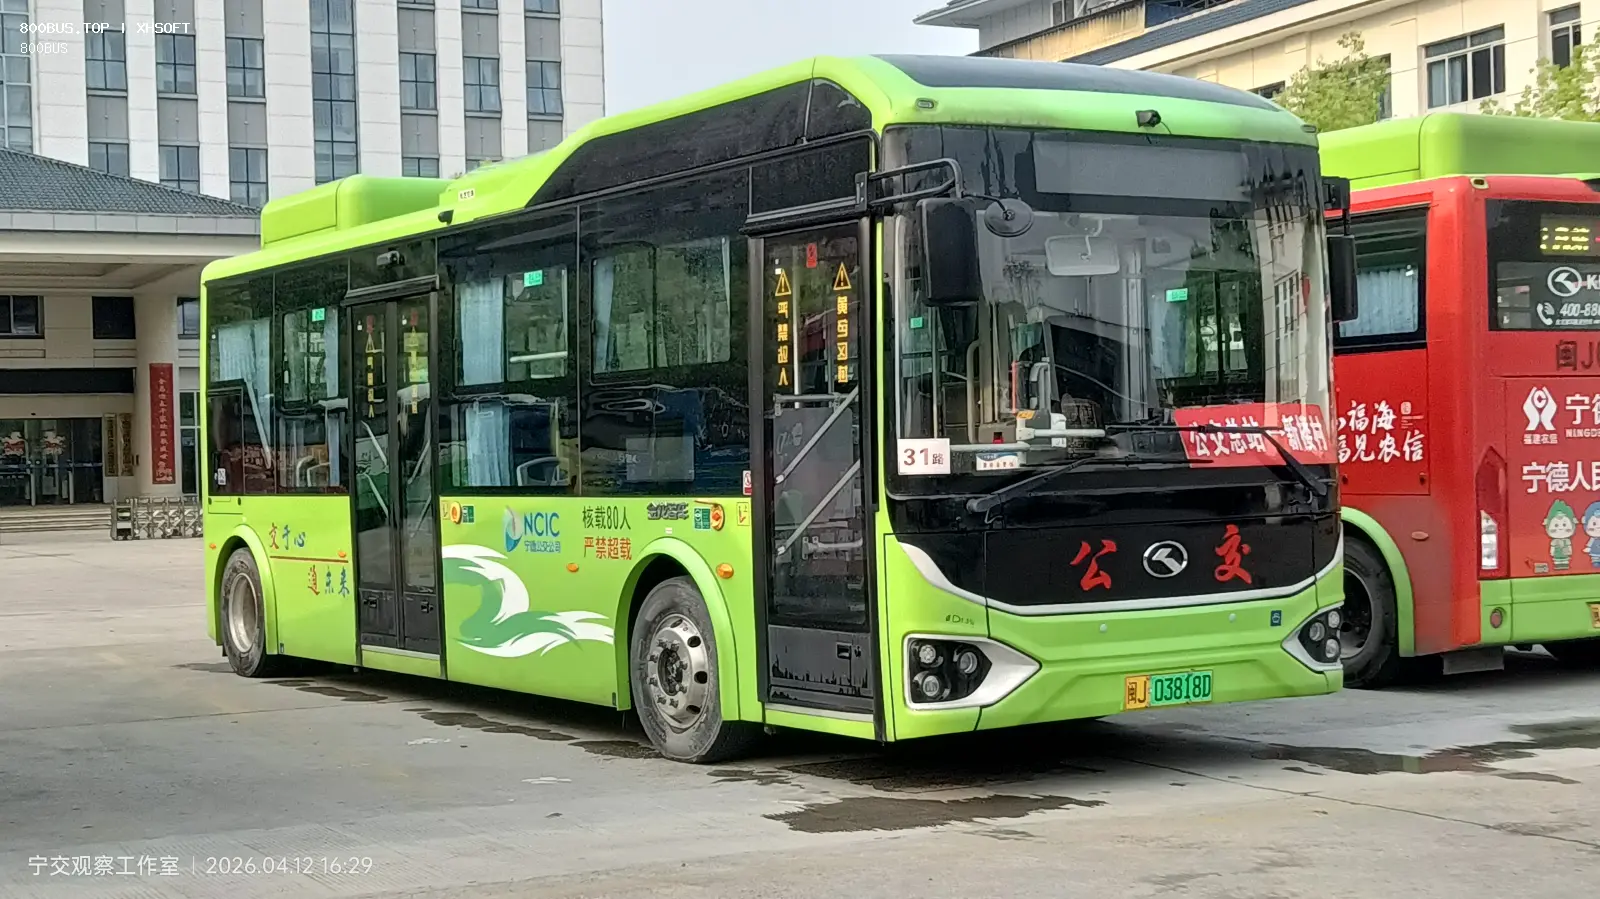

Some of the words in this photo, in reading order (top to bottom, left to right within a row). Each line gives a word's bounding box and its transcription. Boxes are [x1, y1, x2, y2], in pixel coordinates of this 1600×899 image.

[1586, 274, 1600, 290] K
[1555, 339, 1600, 372] 闽J
[903, 448, 944, 466] 31路
[524, 512, 560, 537] NCIC
[582, 505, 631, 530] 核载80人
[583, 536, 632, 561] 严禁超载
[1070, 540, 1117, 591] 公
[1214, 525, 1252, 584] 交
